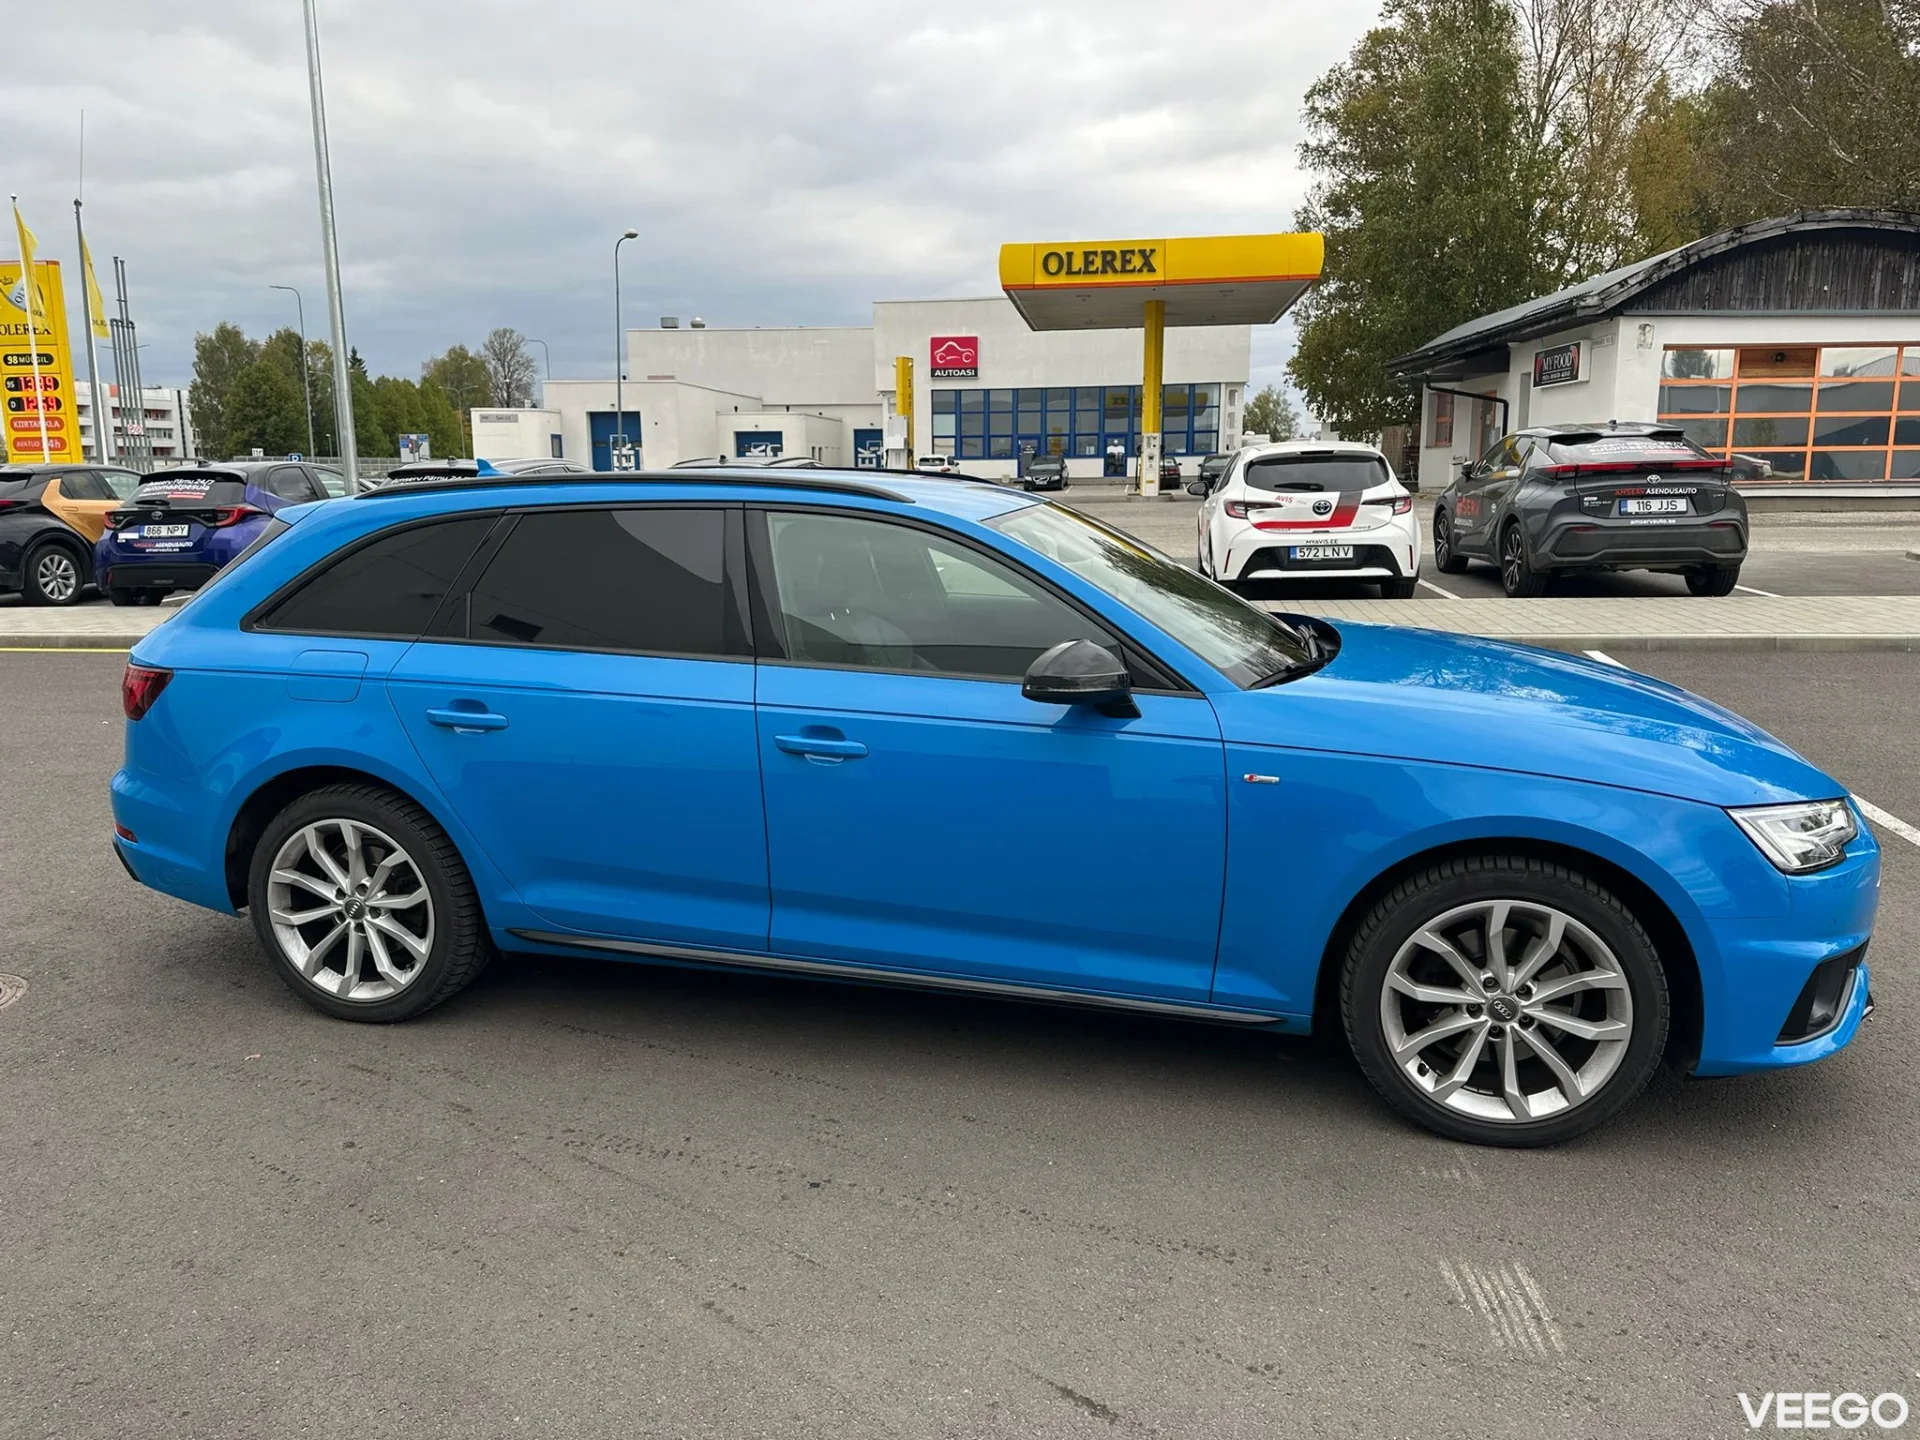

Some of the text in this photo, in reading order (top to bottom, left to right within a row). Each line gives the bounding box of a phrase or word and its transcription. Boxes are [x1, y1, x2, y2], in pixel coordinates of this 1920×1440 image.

[1042, 249, 1157, 276] OLEREX
[7, 356, 18, 364] 98
[934, 369, 975, 377] AUTOASI
[13, 420, 60, 428] KIIRTAKLA
[1646, 487, 1697, 495] ASENDUSAUTO
[1275, 495, 1294, 503] AVIS
[1636, 500, 1678, 511] 116 JJS
[146, 526, 186, 536] 866 NPY
[1300, 547, 1320, 558] 572
